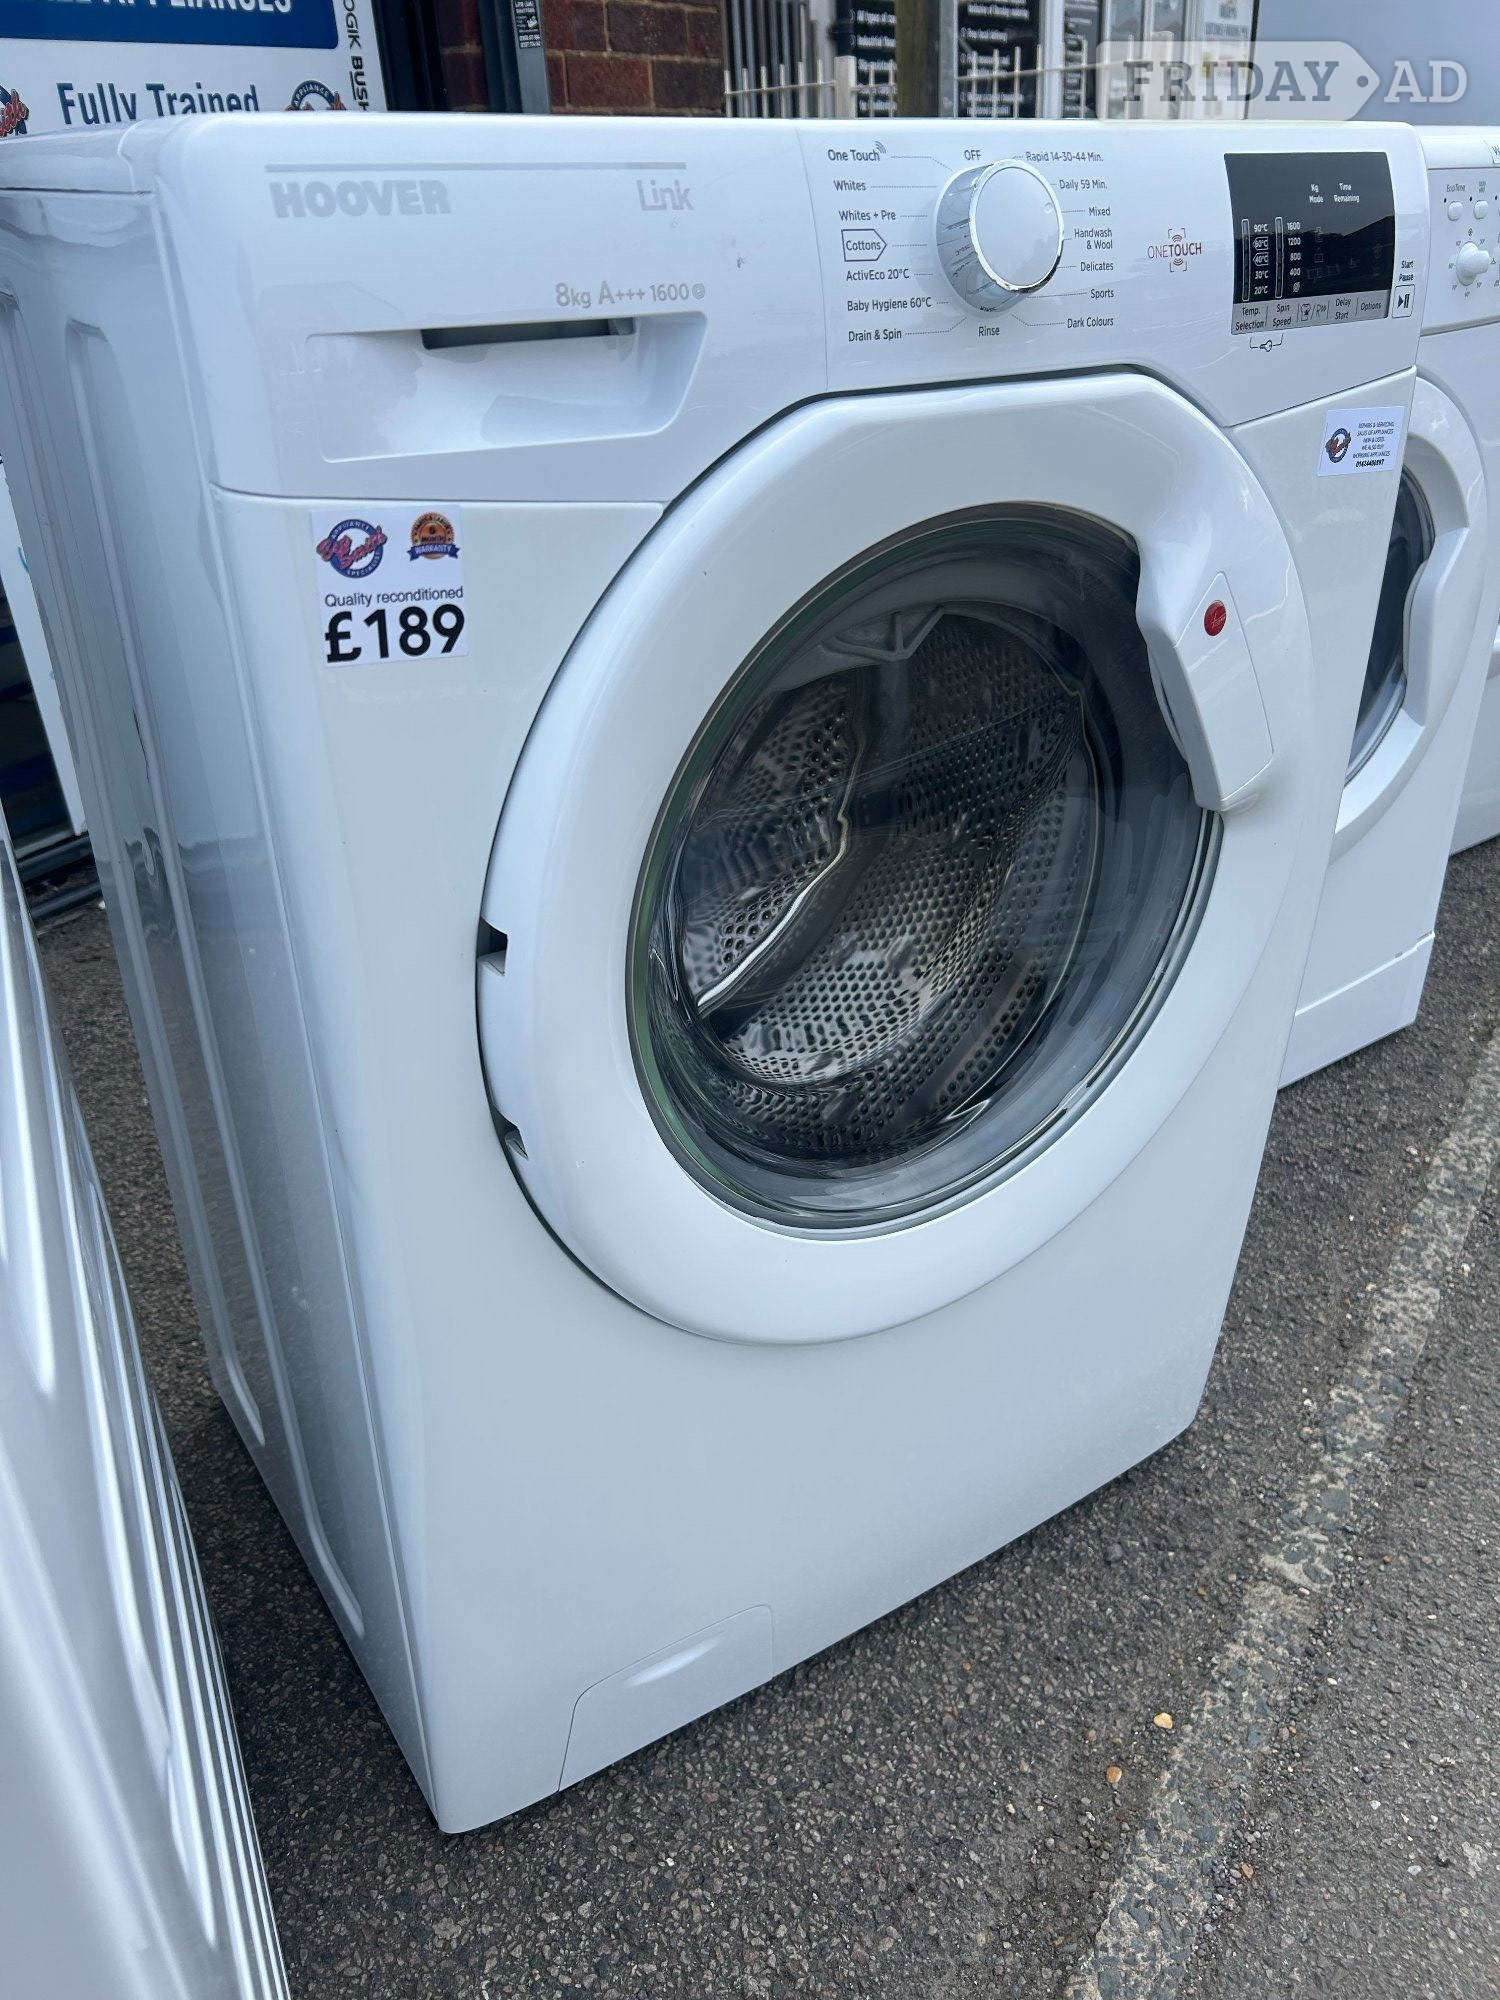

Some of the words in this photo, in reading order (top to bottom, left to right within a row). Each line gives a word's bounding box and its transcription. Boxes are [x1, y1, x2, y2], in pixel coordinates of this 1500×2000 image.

[343, 0, 361, 49] OGIK
[293, 81, 331, 106] APPLIANCE
[56, 82, 137, 125] Fully
[145, 82, 260, 117] Trained
[827, 149, 849, 161] One
[850, 149, 880, 161] Touch
[964, 150, 981, 161] OFF
[1026, 152, 1049, 163] Rapid
[1051, 152, 1086, 162] 14-30-44
[1087, 152, 1104, 162] Min.
[834, 180, 866, 191] Whites
[1059, 180, 1078, 191] Daily
[1080, 180, 1090, 190] 59
[1092, 180, 1108, 190] Min.
[1311, 183, 1319, 192] Kg
[1338, 183, 1352, 191] Time
[269, 180, 451, 218] HOOVER
[636, 179, 695, 212] Link
[1309, 195, 1323, 203] Mode
[1333, 194, 1360, 203] Remaining
[839, 210, 870, 221] Whites
[880, 210, 896, 221] Pre
[1088, 206, 1111, 216] Mixed
[1287, 222, 1301, 230] 1600
[1074, 228, 1112, 239] Handwash
[846, 240, 881, 251] Cottons
[1086, 239, 1092, 249] &
[1094, 239, 1113, 249] Wool
[1288, 237, 1301, 246] 1200
[1148, 242, 1202, 258] ONETOUCH
[1290, 252, 1301, 261] 800
[1080, 261, 1114, 272] Delicates
[1401, 260, 1414, 269] Start
[846, 269, 885, 281] ActivEco
[887, 268, 910, 280] 20°C
[1290, 268, 1301, 276] 400
[1399, 272, 1414, 282] Pause
[555, 281, 592, 309] 8kg
[598, 280, 646, 307] A+++
[650, 283, 690, 303] 1600
[1090, 288, 1114, 299] Sports
[847, 299, 870, 312] Baby
[872, 298, 908, 311] Hygiene
[910, 297, 932, 309] 60°C
[1277, 303, 1290, 313] Spin
[1335, 298, 1351, 307] Delay
[1360, 302, 1382, 312] Options
[1242, 307, 1260, 317] Temp.
[1335, 311, 1348, 320] Start
[1067, 317, 1085, 328] Dark
[1086, 316, 1114, 327] Colours
[1235, 320, 1264, 331] Selection
[1273, 317, 1292, 328] Speed
[848, 330, 872, 342] Drain
[874, 330, 881, 341] &
[882, 328, 902, 341] Spin
[978, 326, 1000, 338] Rinse
[325, 592, 372, 608] Quality
[377, 586, 464, 603] reconditioned
[324, 603, 465, 663] £189
